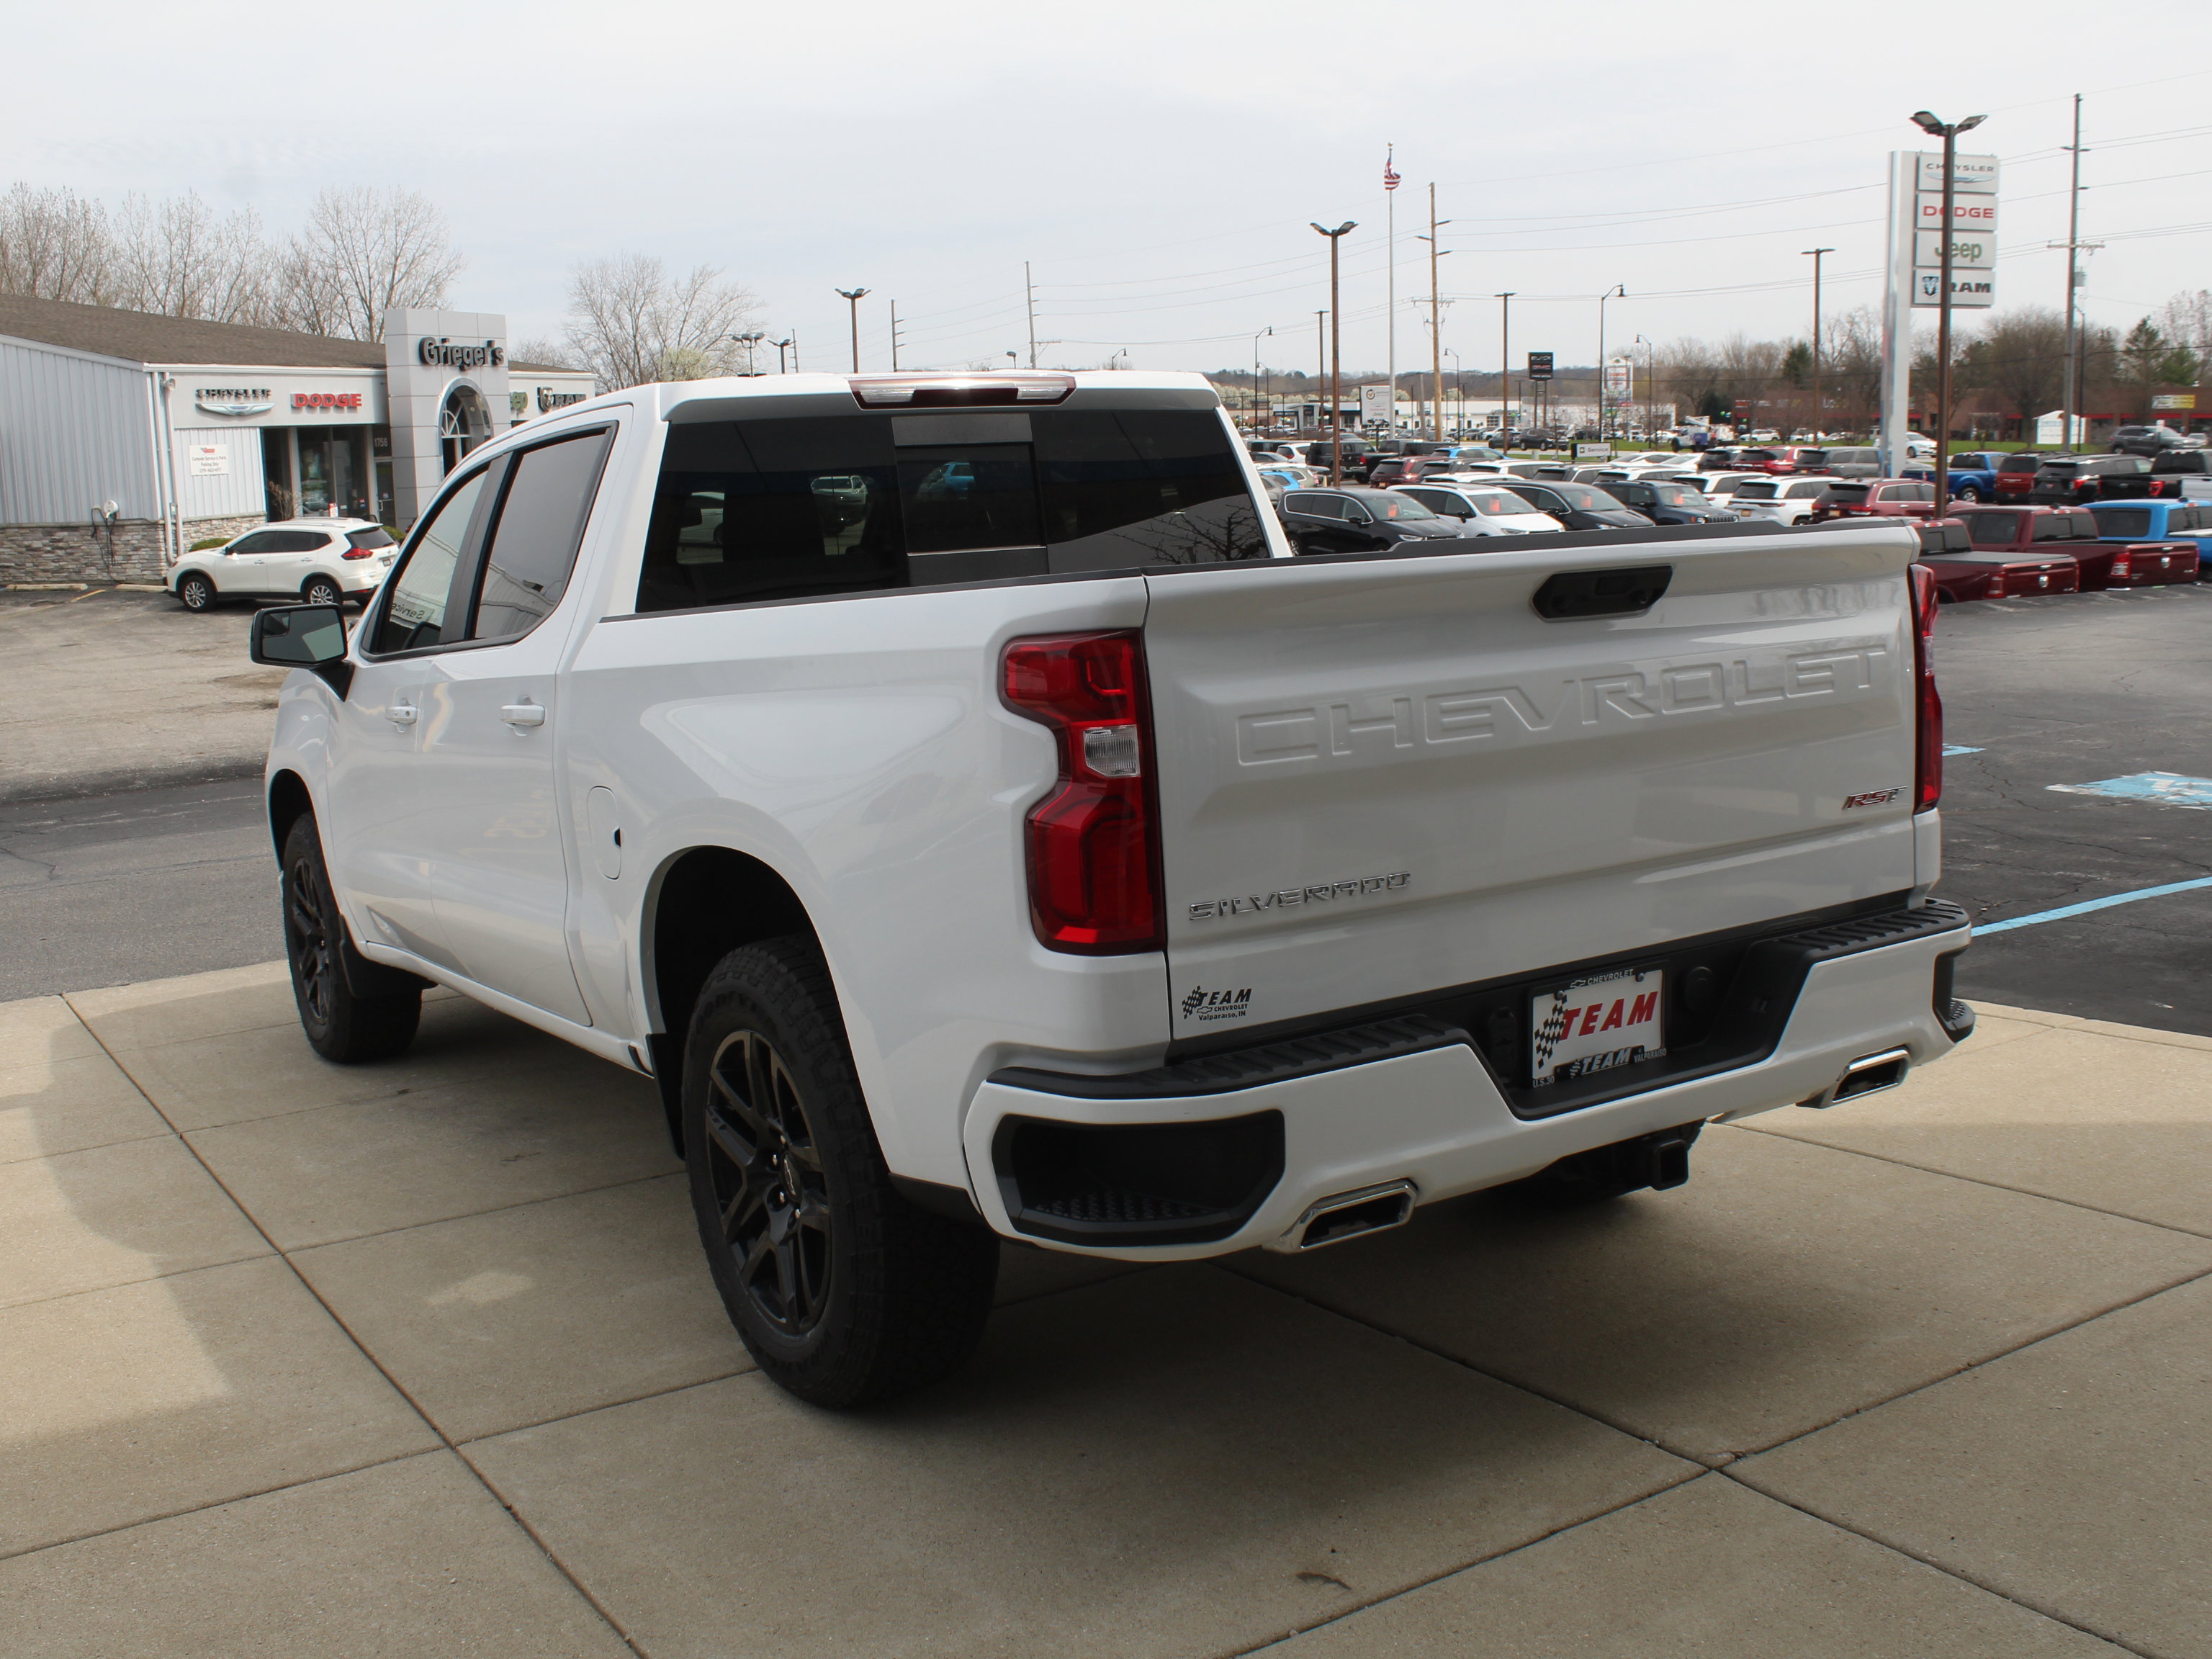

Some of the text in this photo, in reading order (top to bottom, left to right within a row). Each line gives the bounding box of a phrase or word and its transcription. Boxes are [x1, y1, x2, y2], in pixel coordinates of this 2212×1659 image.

[1926, 163, 1995, 172] CHYSLER
[419, 337, 504, 371] Grieger's
[196, 389, 271, 397] CHRYSLER
[293, 393, 362, 408] DODGE
[554, 394, 587, 405] RAM
[374, 438, 388, 447] 1756
[1238, 646, 1886, 765] CHEVROLET
[1842, 786, 1907, 810] RST
[1190, 871, 1411, 920] SILVERADO
[1588, 968, 1634, 985] CHEVROLET
[1198, 989, 1251, 1007] TEAM
[1199, 1012, 1237, 1021] Valparaiso,
[1559, 991, 1658, 1041] TEAM
[1581, 1047, 1632, 1074] TEAM
[1634, 1048, 1667, 1063] VALPARAISO
